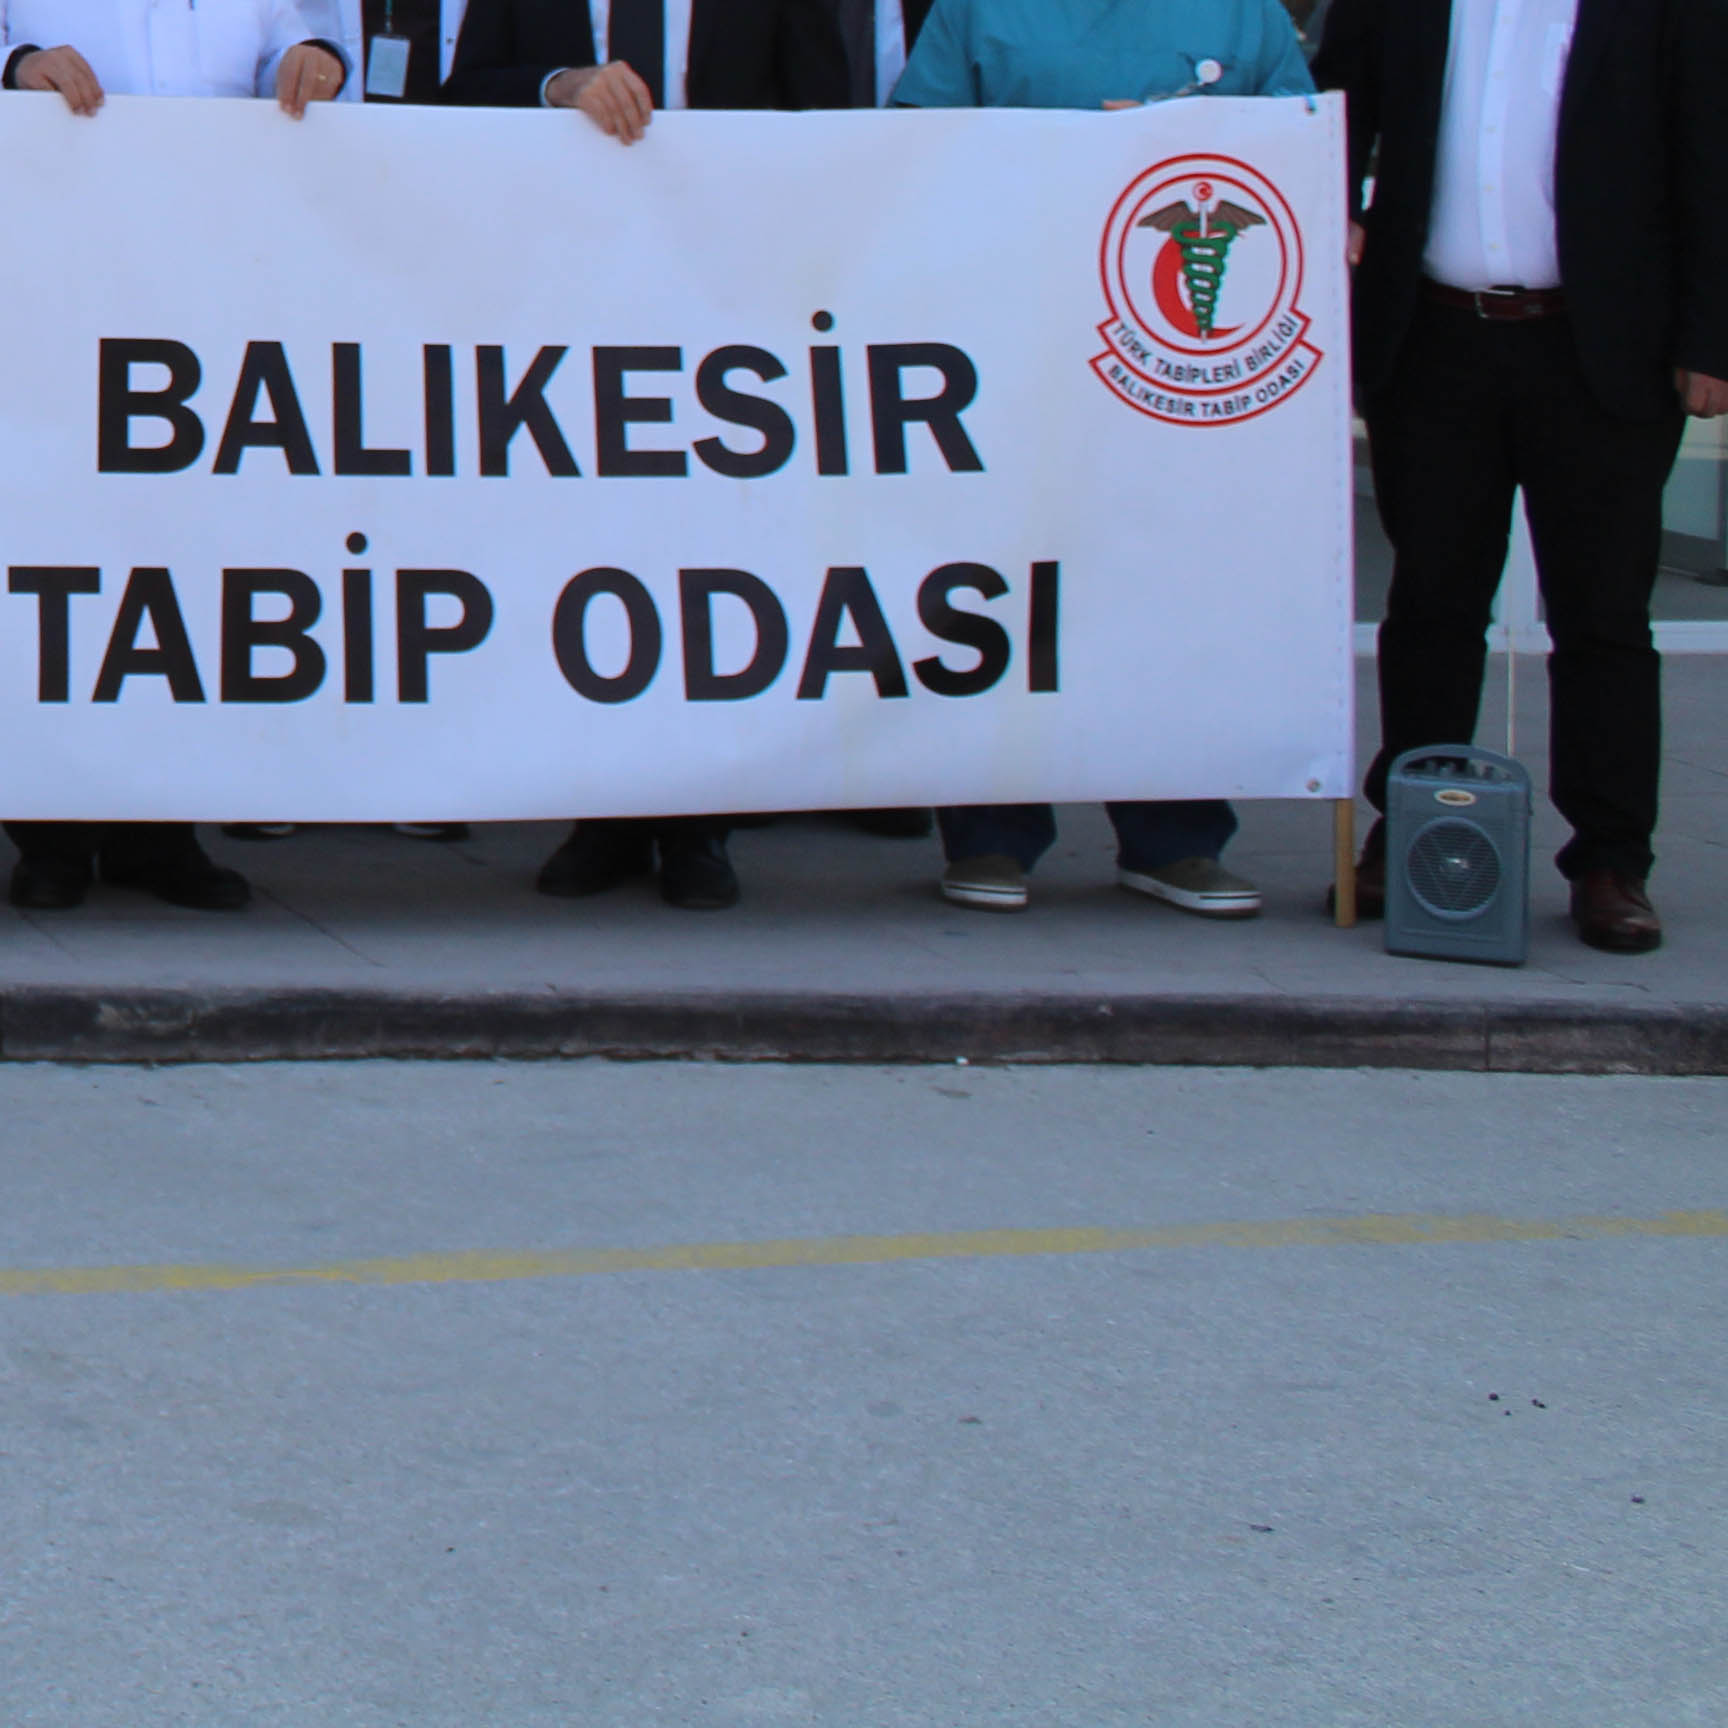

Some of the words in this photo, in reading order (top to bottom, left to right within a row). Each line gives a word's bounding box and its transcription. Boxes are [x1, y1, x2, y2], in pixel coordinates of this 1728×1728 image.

[98, 311, 983, 477] BALIKESİR
[1107, 363, 1195, 417] BALIKESİR
[1200, 395, 1252, 418] TABİP
[1255, 359, 1306, 405] ODASI
[1113, 322, 1151, 367] TÜRK
[1155, 358, 1242, 385] TABİPLERİ
[1246, 314, 1299, 373] BİRLİĞİ
[9, 533, 492, 702] TABİP
[553, 561, 1058, 702] ODASI
